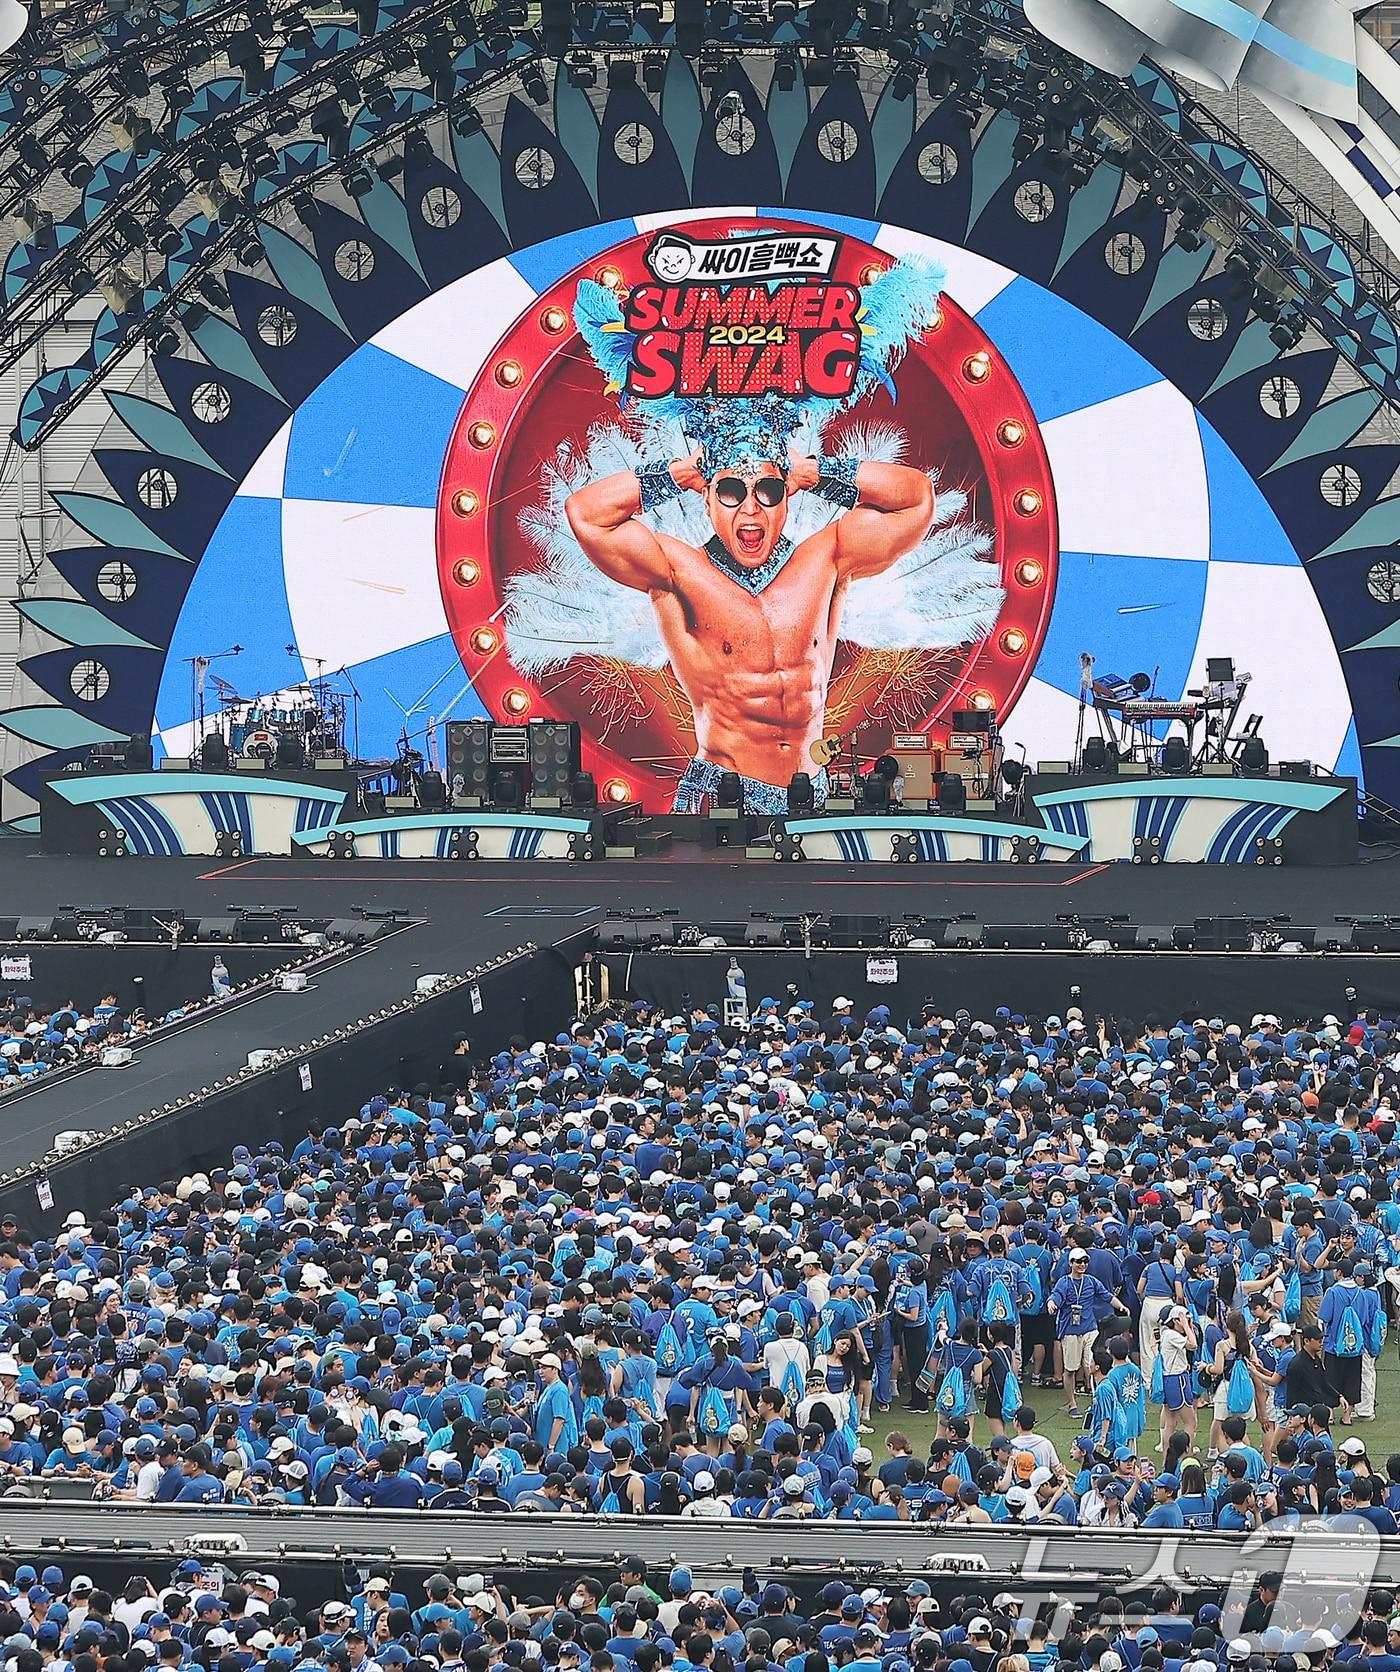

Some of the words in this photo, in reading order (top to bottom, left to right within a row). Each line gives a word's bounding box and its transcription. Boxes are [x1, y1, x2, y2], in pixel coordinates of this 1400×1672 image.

[698, 241, 823, 275] 싸이흠뻑쇼
[629, 286, 855, 330] SUMMER
[708, 325, 786, 345] 2024
[629, 330, 857, 395] SWAG
[201, 1580, 219, 1592] 주의
